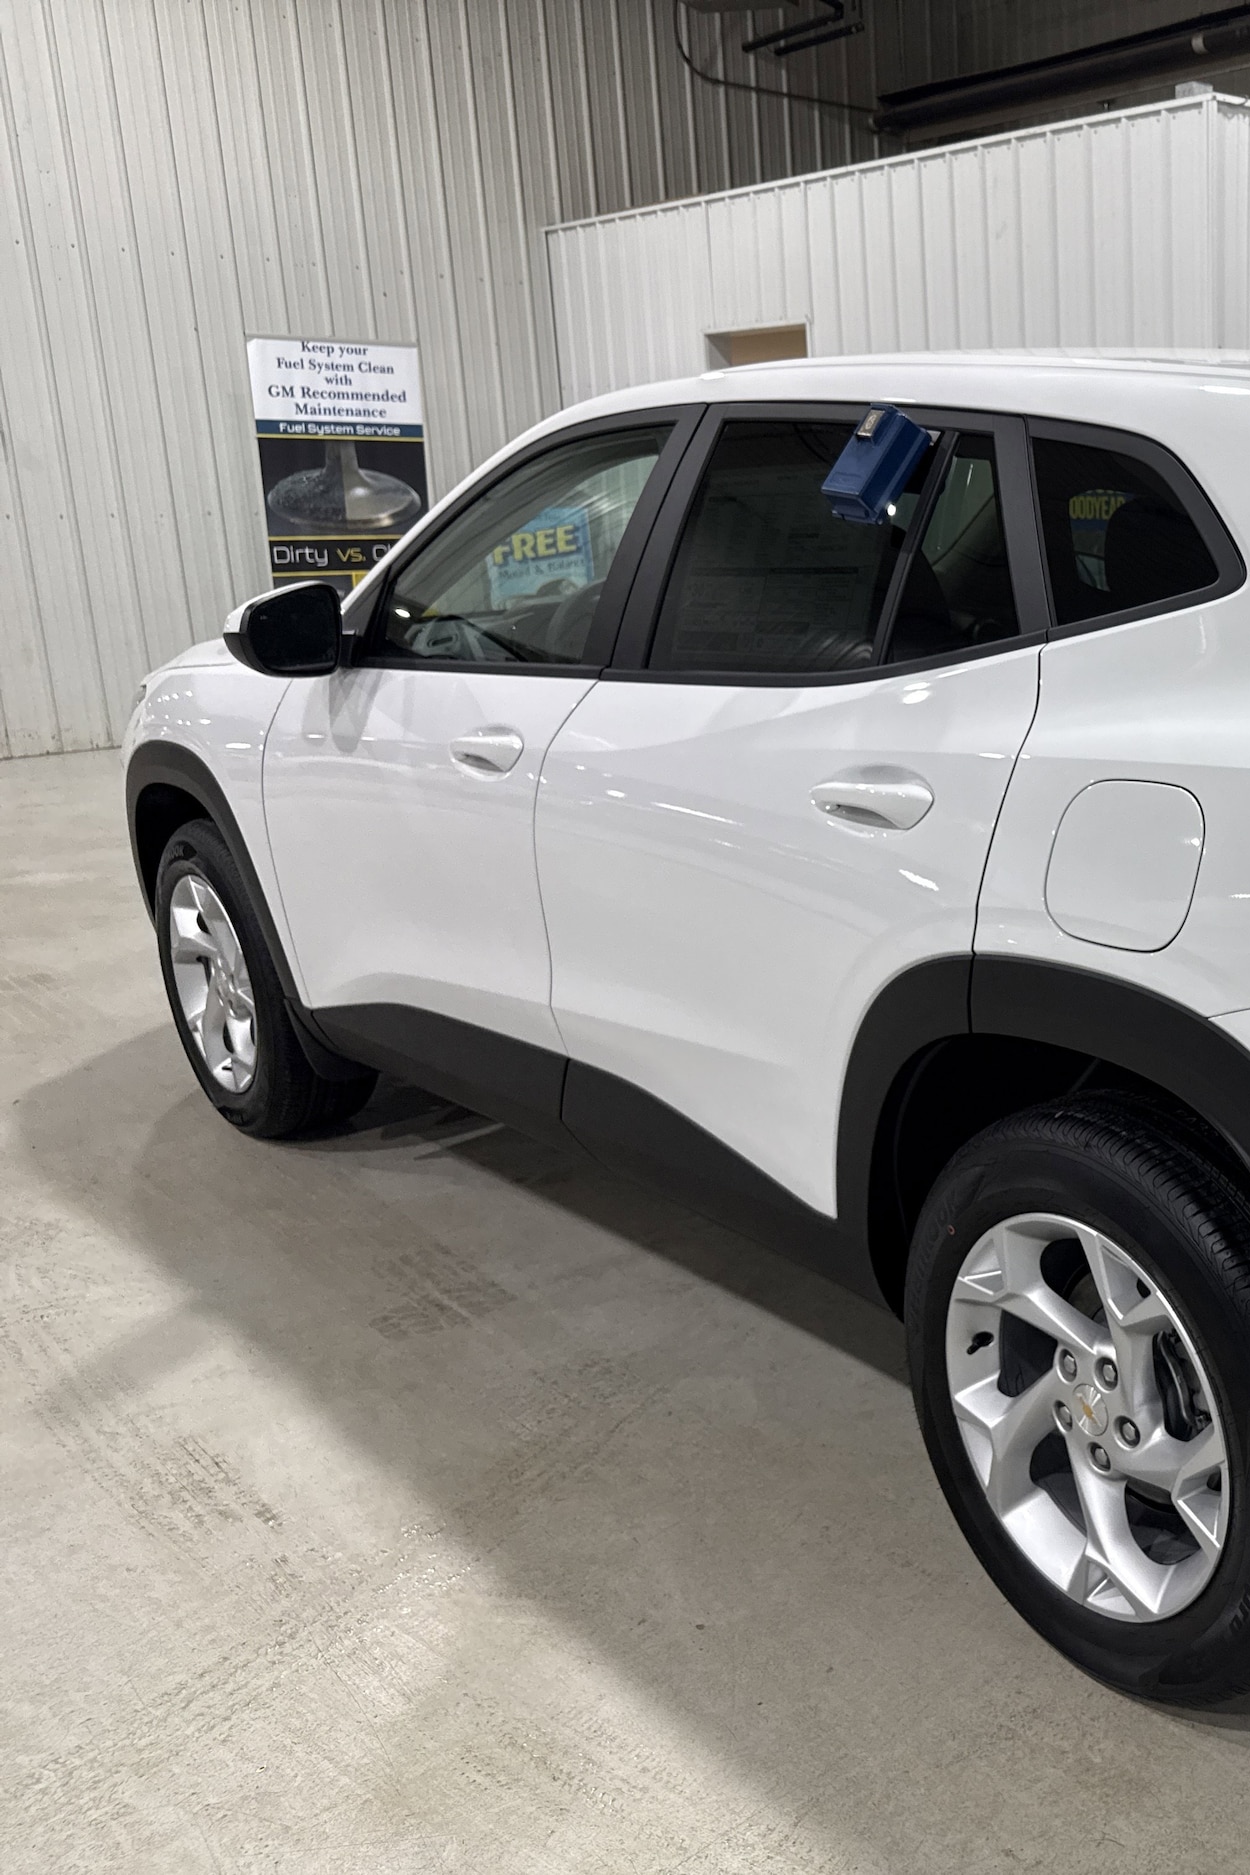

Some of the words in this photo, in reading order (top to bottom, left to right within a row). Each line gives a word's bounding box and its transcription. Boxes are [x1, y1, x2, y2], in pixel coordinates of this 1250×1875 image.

[301, 340, 335, 357] Keep
[337, 346, 368, 358] your
[276, 357, 304, 370] Fuel
[308, 359, 354, 374] System
[358, 361, 394, 375] Clean
[324, 373, 352, 386] with
[268, 385, 295, 399] GM
[300, 386, 407, 403] Recommended
[295, 403, 387, 418] Maintenance
[279, 422, 305, 433] Fuel
[308, 423, 354, 435] System
[356, 424, 400, 436] Service
[493, 525, 577, 565] FREE
[273, 545, 328, 567] Dirty
[336, 548, 366, 563] vs.
